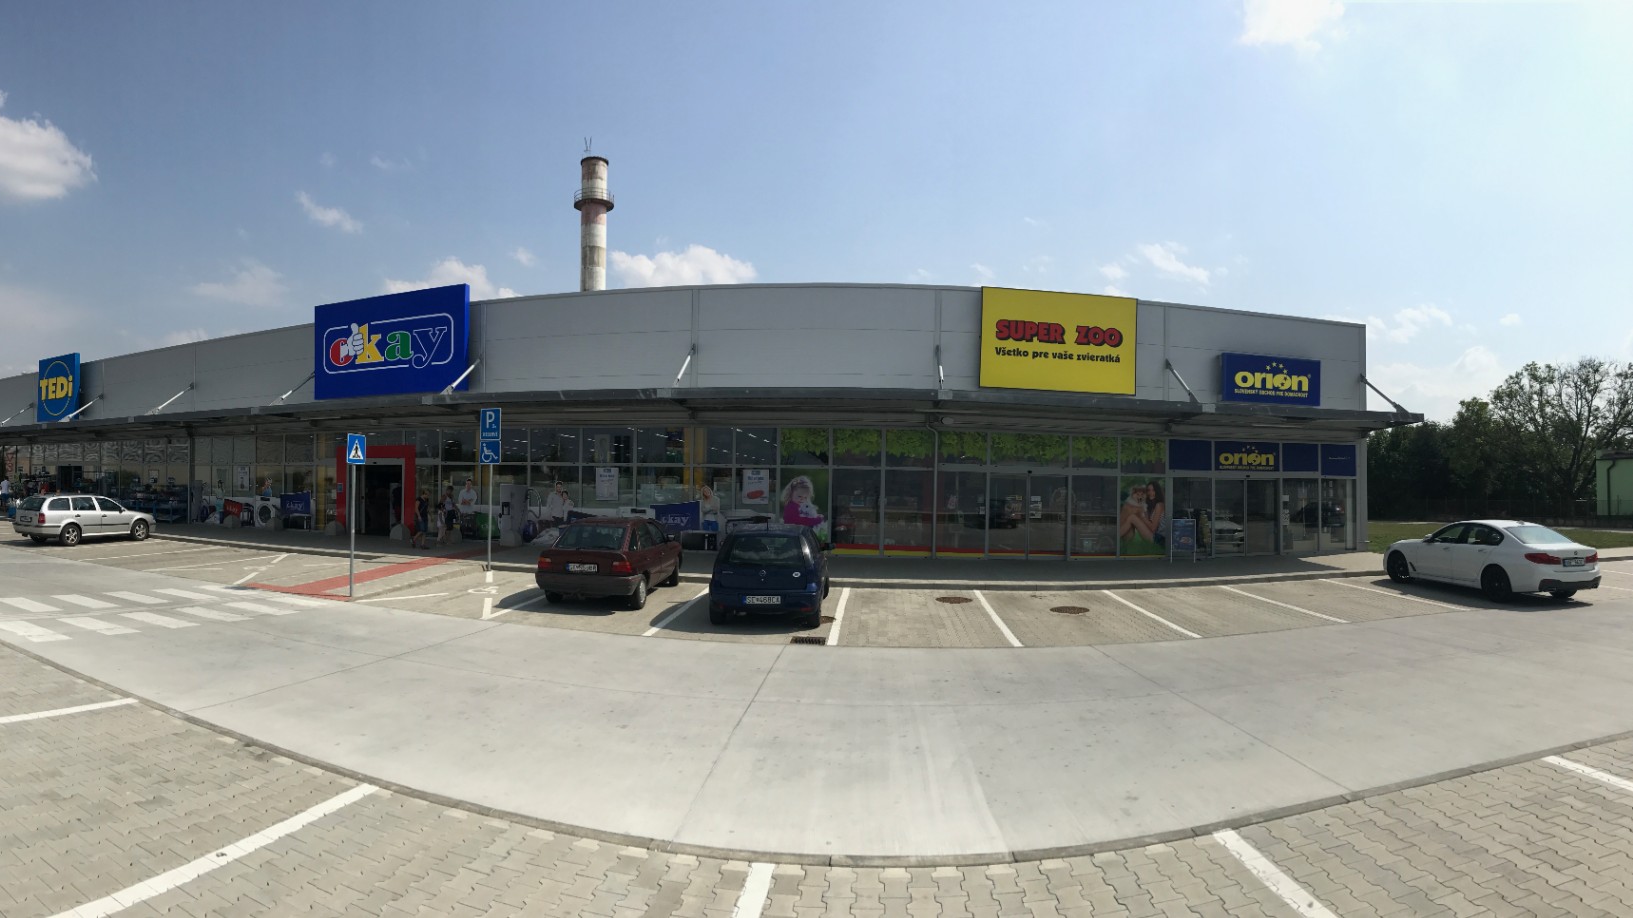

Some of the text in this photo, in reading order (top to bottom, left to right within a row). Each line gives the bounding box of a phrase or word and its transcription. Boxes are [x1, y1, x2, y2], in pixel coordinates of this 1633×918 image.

[995, 319, 1123, 347] SUPER ZOO
[995, 346, 1121, 363] Všetko pre vaše zvieratká
[39, 375, 73, 401] TEDi
[1234, 371, 1309, 392] orion
[486, 411, 495, 429] P
[1219, 452, 1275, 466] orion
